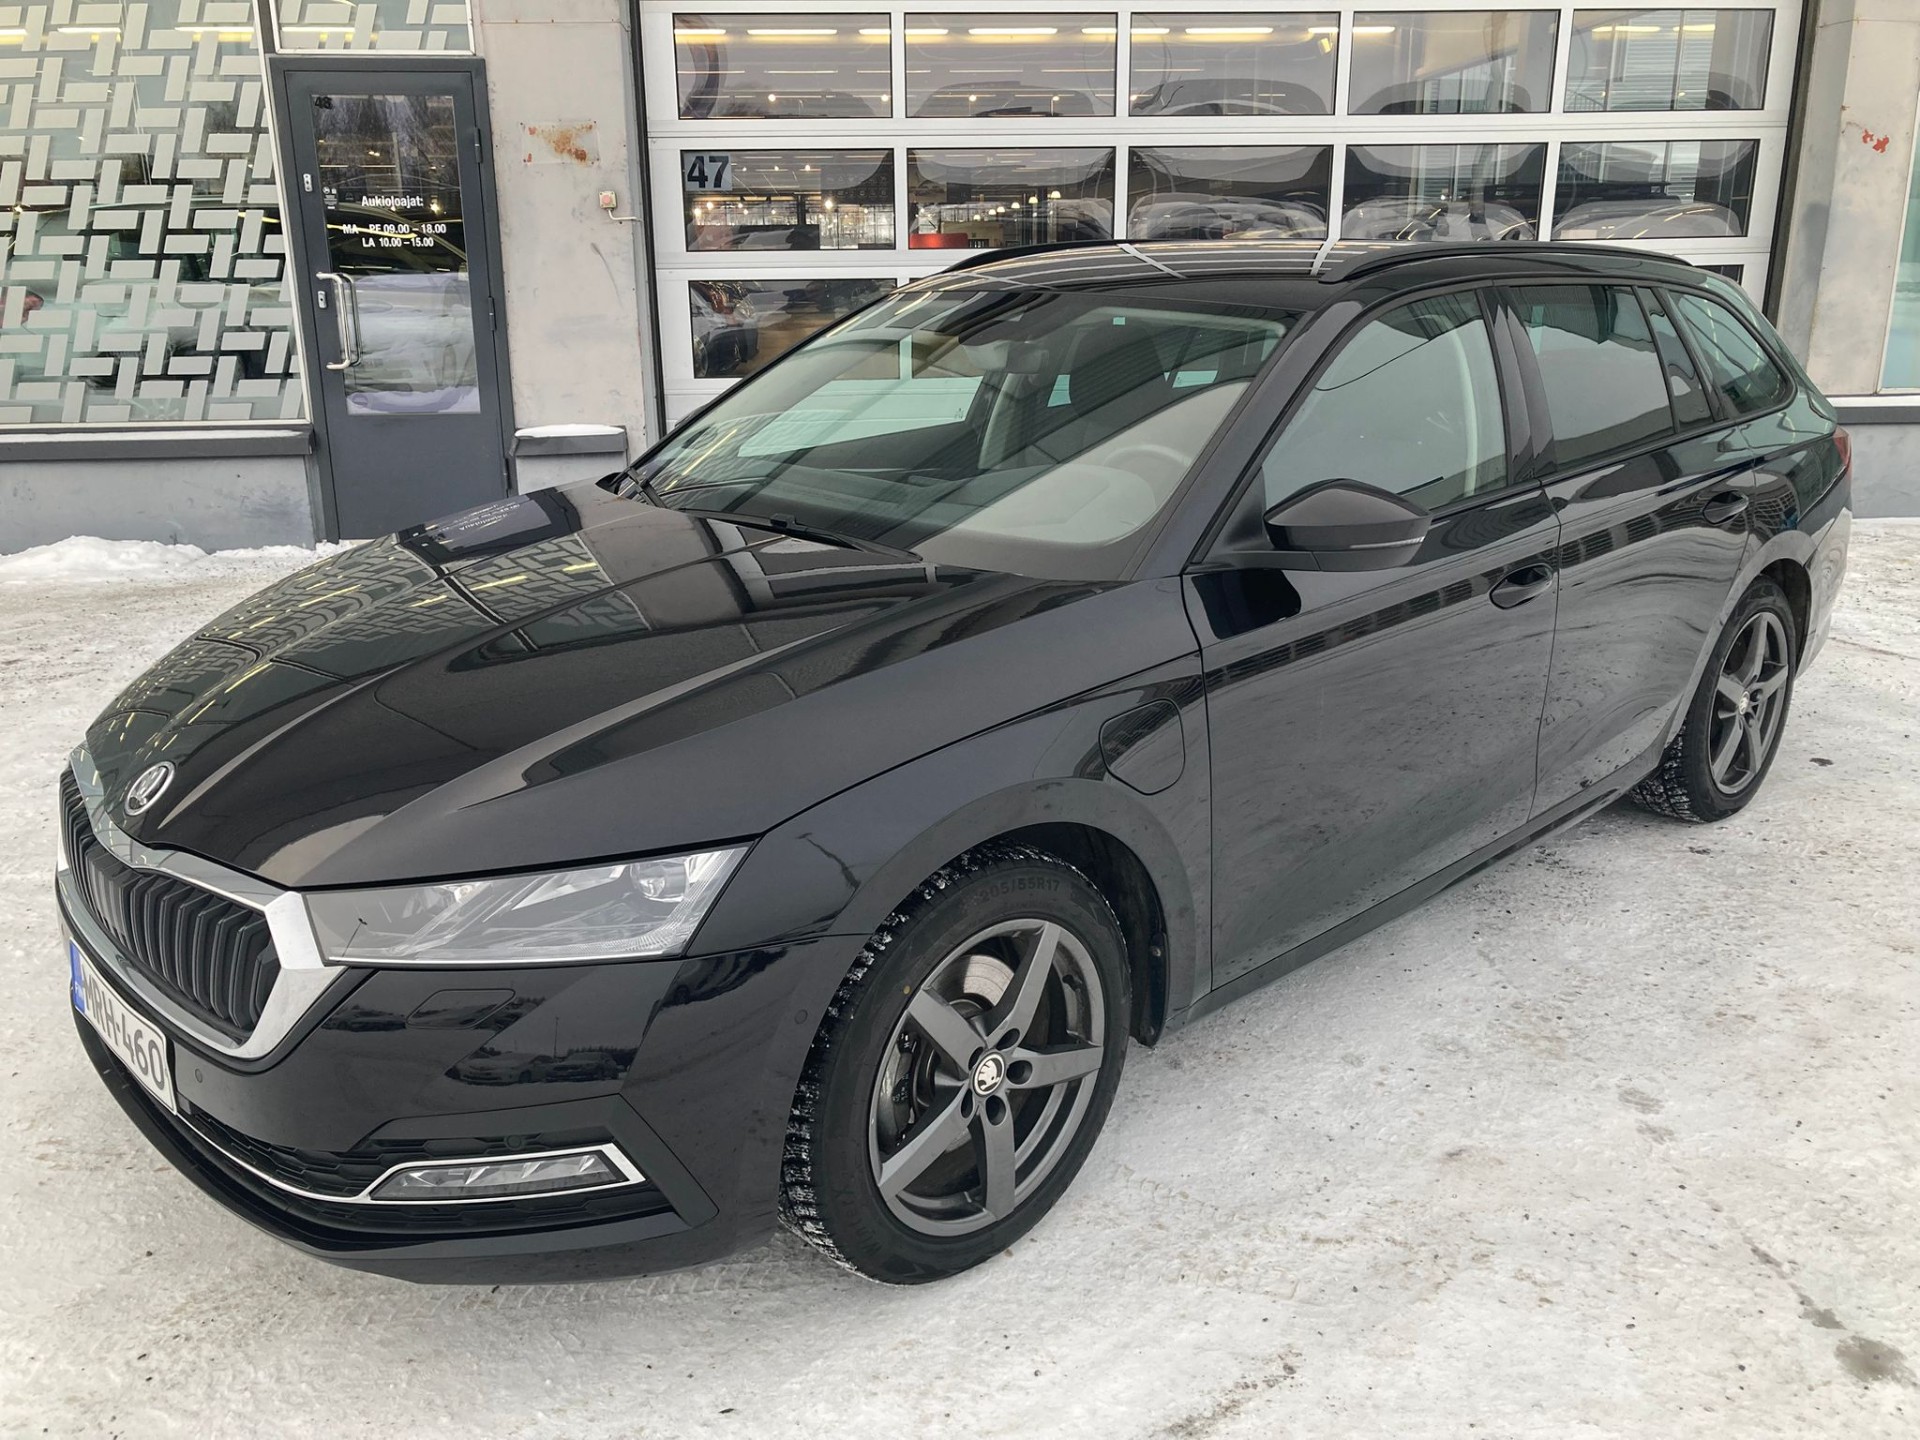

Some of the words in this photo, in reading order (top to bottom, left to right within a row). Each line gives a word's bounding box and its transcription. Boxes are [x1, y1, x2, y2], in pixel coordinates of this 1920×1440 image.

[687, 155, 730, 188] 47
[361, 195, 424, 209] Aukioloajat:
[342, 223, 359, 234] MA
[383, 223, 410, 234] 09.00
[420, 223, 447, 234] 18.00
[361, 237, 376, 248] LA
[379, 237, 402, 248] 10.00
[411, 236, 434, 247] 15.00
[82, 963, 165, 1091] MRH-460
